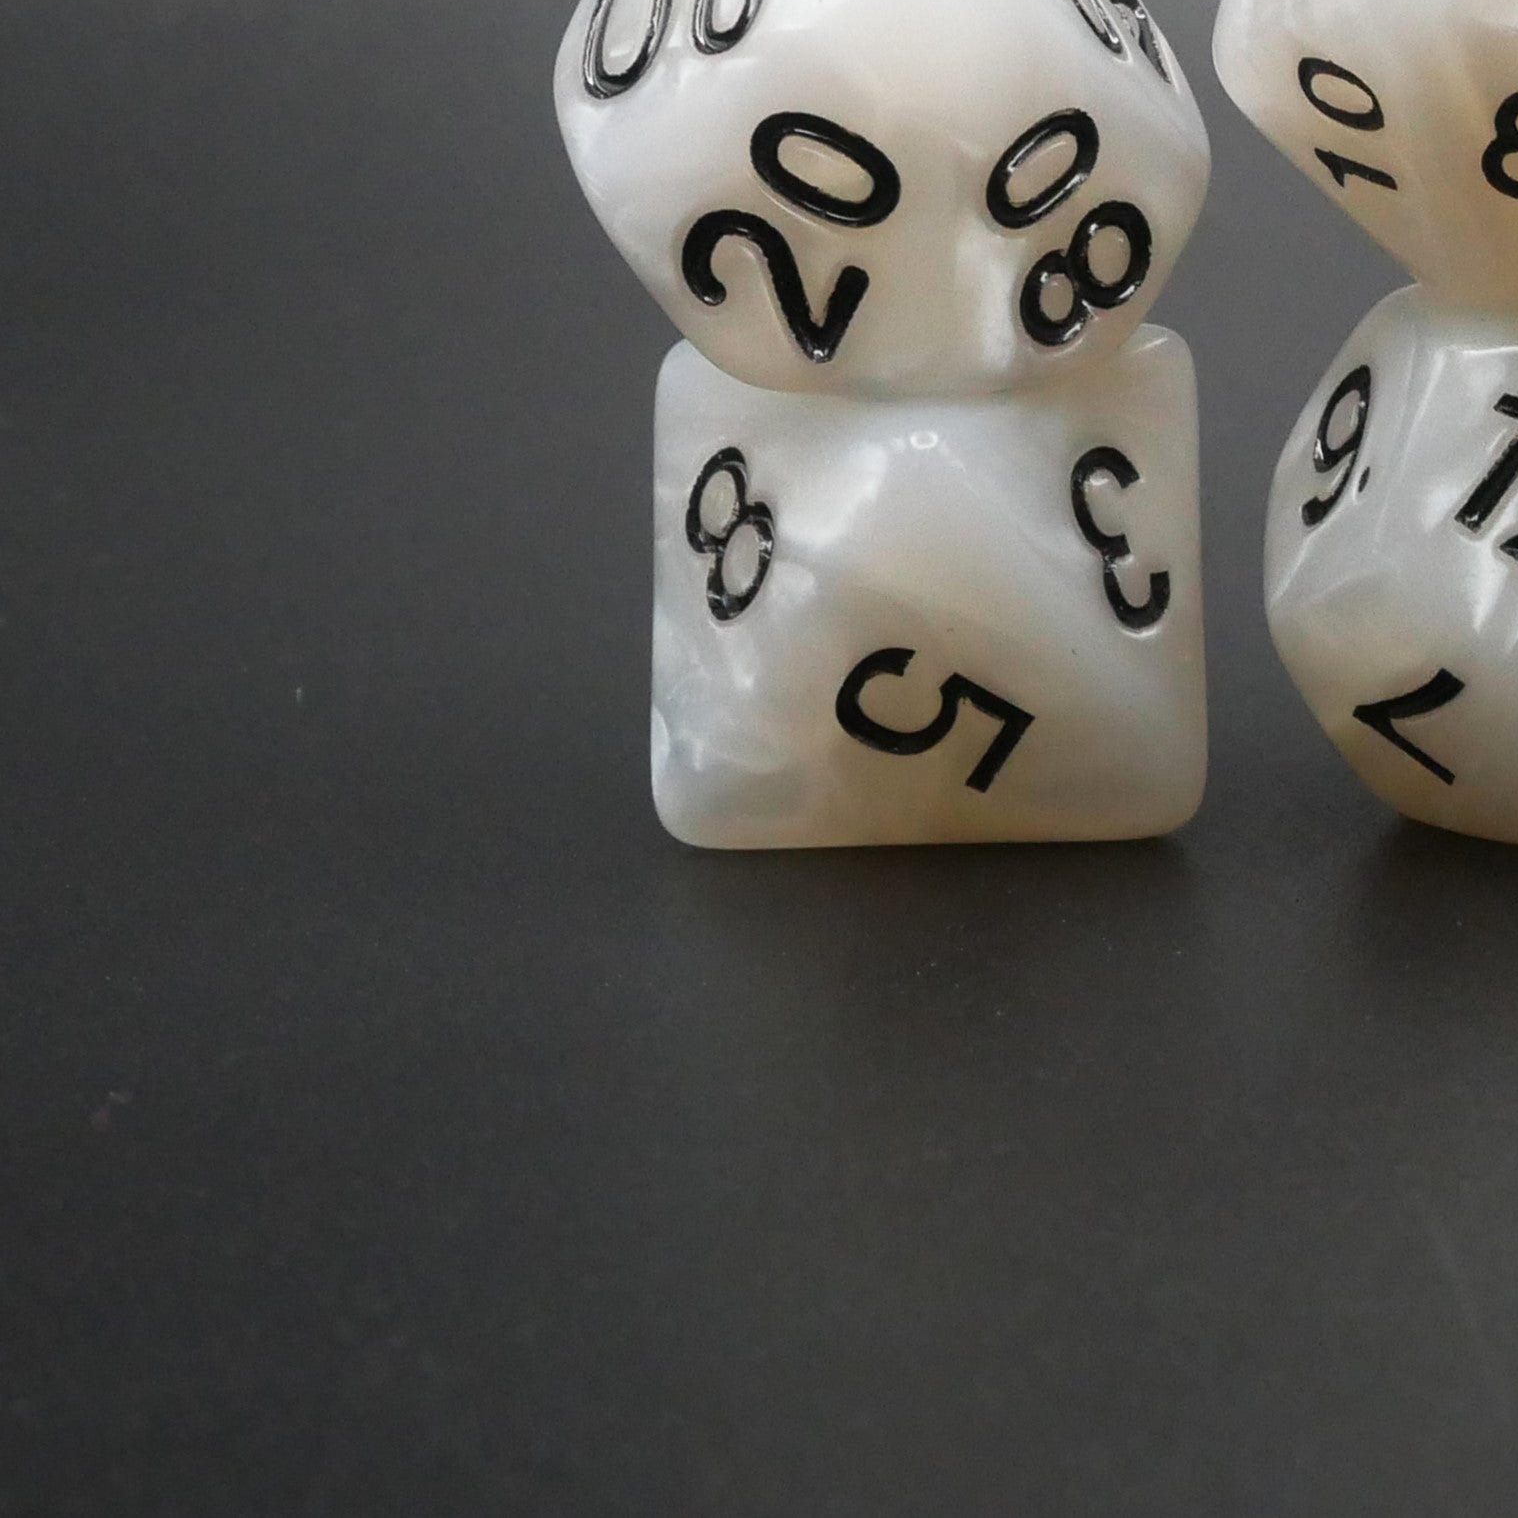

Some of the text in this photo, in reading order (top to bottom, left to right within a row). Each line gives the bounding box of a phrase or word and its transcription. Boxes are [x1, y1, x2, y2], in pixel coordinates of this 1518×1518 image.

[1299, 56, 1397, 190] 10
[681, 111, 901, 364] 20
[985, 107, 1153, 347] 80
[685, 446, 775, 622] 8
[1070, 446, 1171, 630] 3
[834, 647, 1035, 793] 5
[1352, 668, 1465, 786] 7
